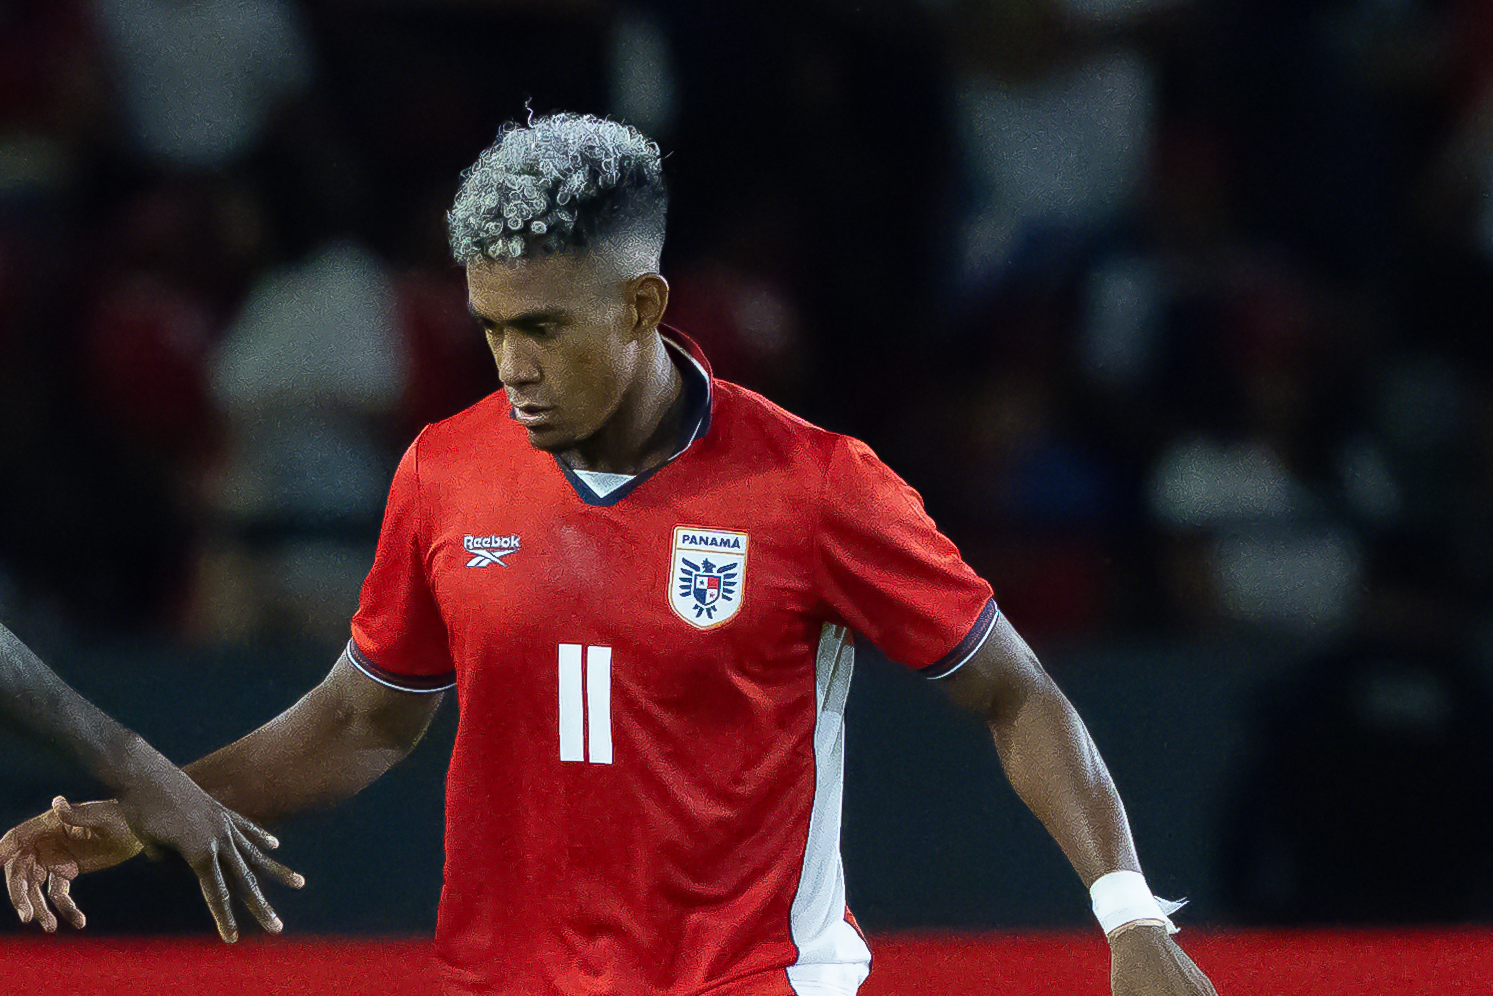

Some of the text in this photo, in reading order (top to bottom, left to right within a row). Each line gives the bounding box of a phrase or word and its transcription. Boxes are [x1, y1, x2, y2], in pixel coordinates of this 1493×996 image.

[463, 534, 520, 550] Reebok
[682, 534, 741, 549] PANAMÁ
[558, 643, 614, 765] 11
